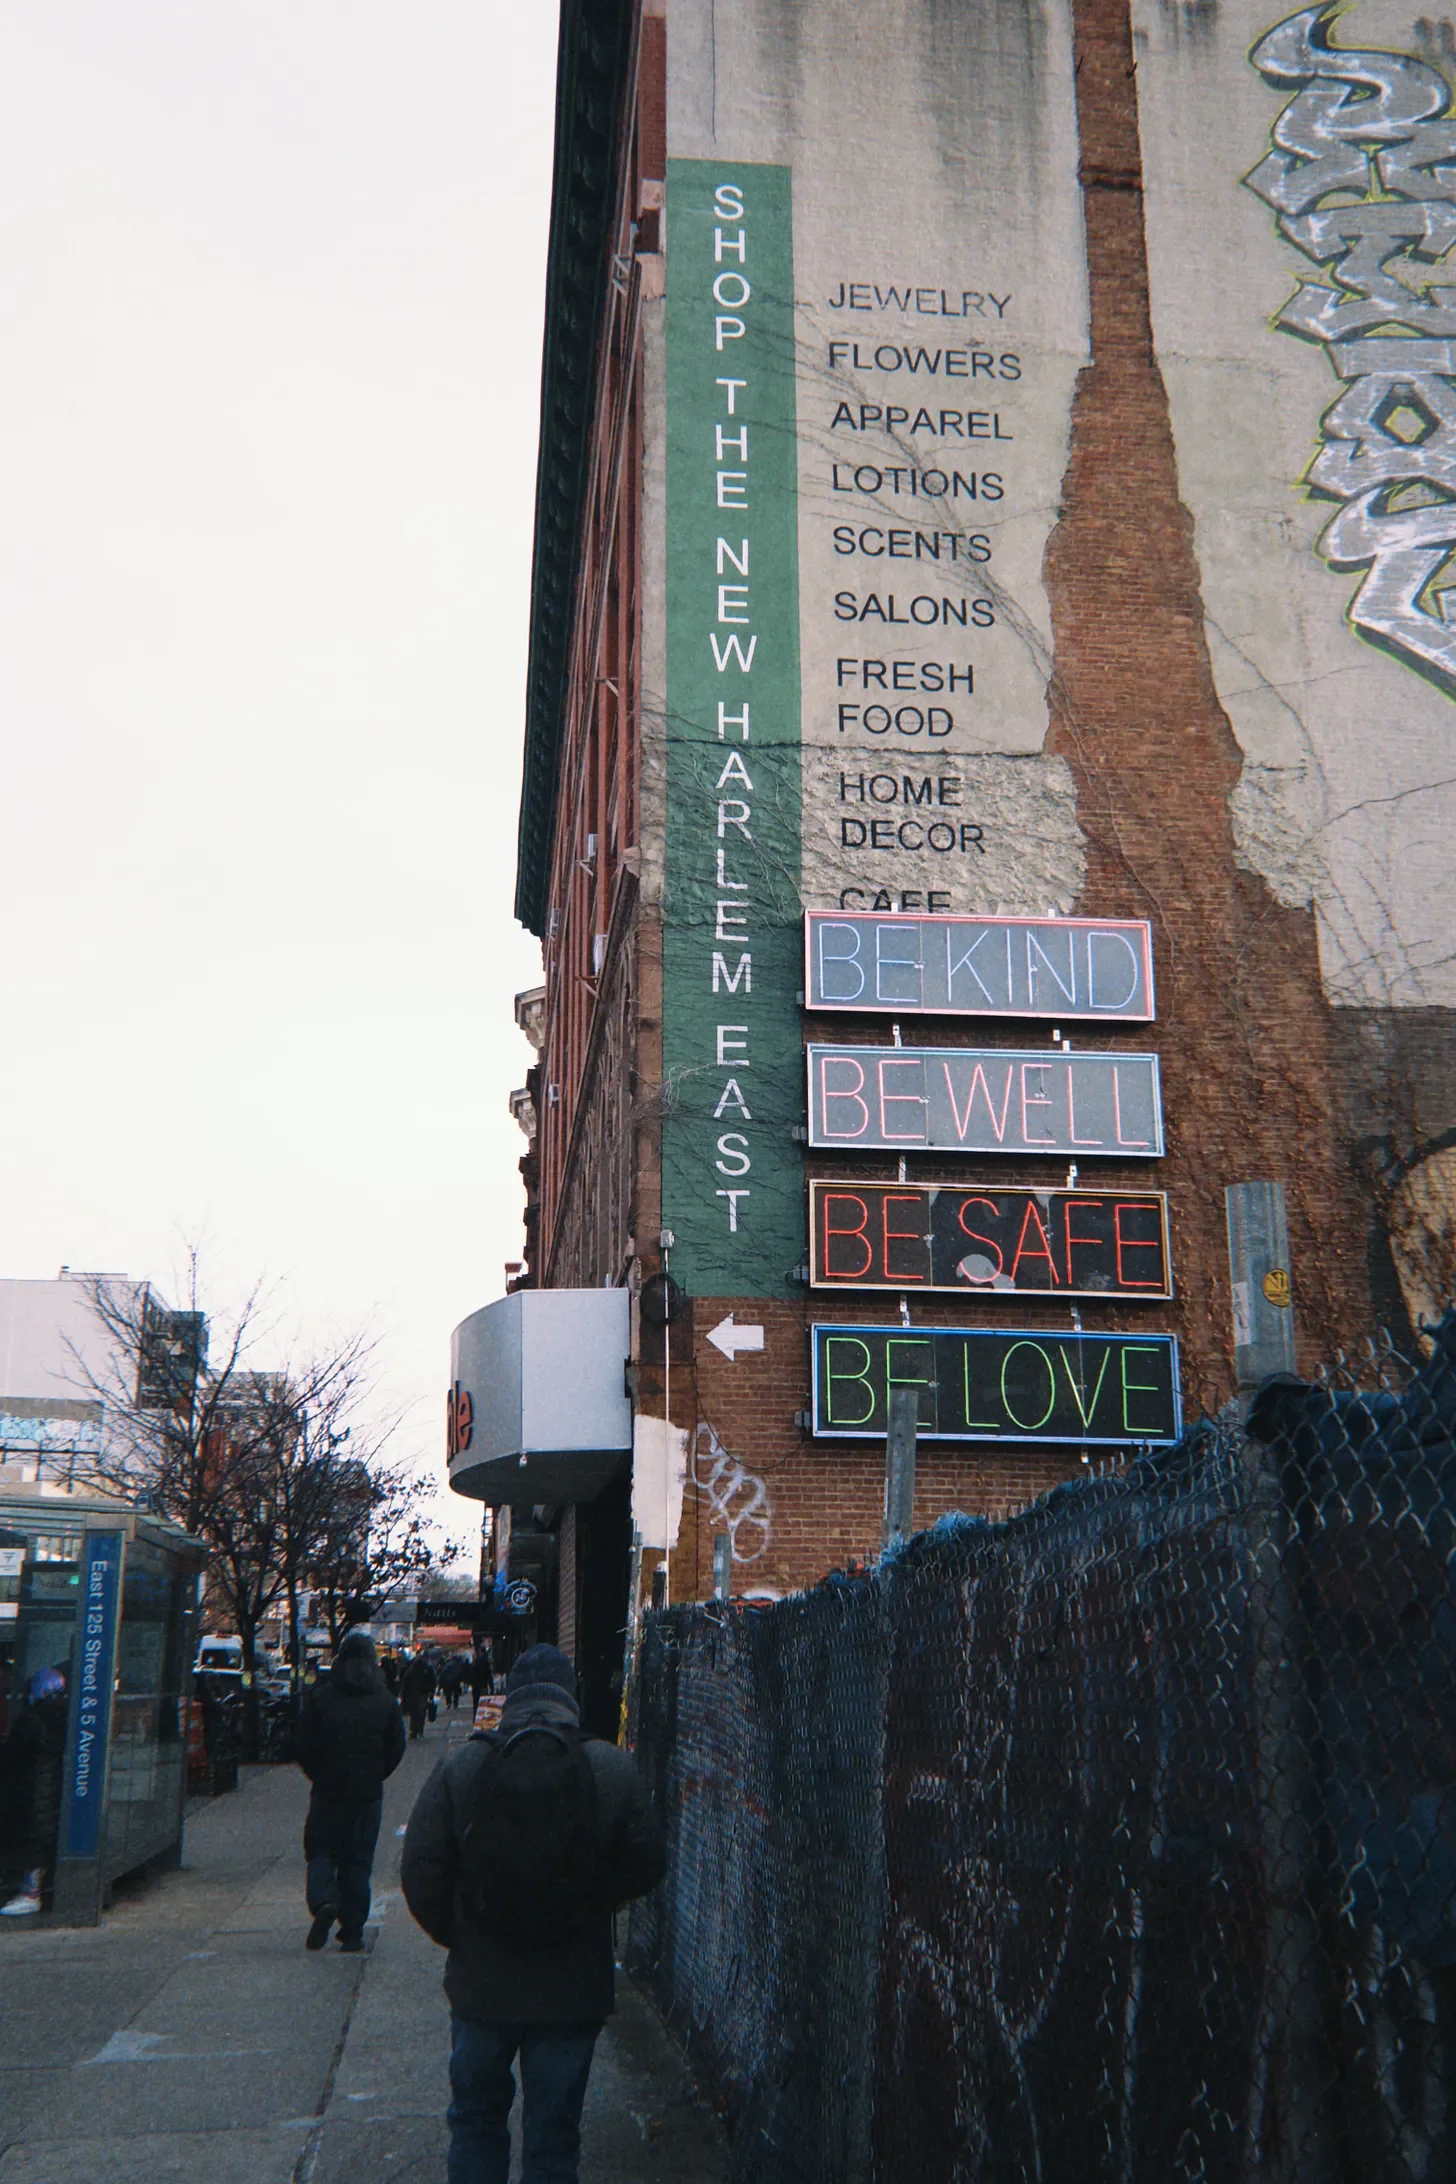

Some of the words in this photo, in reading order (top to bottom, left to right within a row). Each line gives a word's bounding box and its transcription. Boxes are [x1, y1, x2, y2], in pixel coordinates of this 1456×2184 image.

[713, 184, 751, 351] SHOP
[829, 283, 1012, 318] JEWELRY
[829, 342, 1022, 380] FLOWERS
[831, 402, 1013, 440] APPAREL
[715, 377, 748, 509] THE
[832, 464, 1004, 500] LOTIONS
[833, 526, 992, 562] SCENTS
[709, 537, 757, 672] NEW
[834, 591, 995, 627] SALONS
[837, 658, 974, 694] FRESH
[838, 704, 954, 737] FOOD
[840, 772, 961, 807] HOME
[712, 702, 753, 994] HARLEM
[841, 818, 985, 854] DECOR
[819, 923, 918, 1002] BE
[948, 928, 1138, 1008] KIND
[821, 1058, 924, 1139] BE
[944, 1062, 1149, 1146] WELL
[713, 1026, 751, 1233] EAST
[824, 1195, 924, 1279] BE
[958, 1198, 1162, 1287] SAFE
[826, 1337, 931, 1425] BE
[965, 1342, 1163, 1433] LOVE
[89, 1560, 108, 1600] East
[87, 1604, 104, 1634] 125
[83, 1640, 101, 1692] Street
[81, 1697, 98, 1709] &
[81, 1715, 96, 1725] 5
[76, 1730, 95, 1797] Avenue
